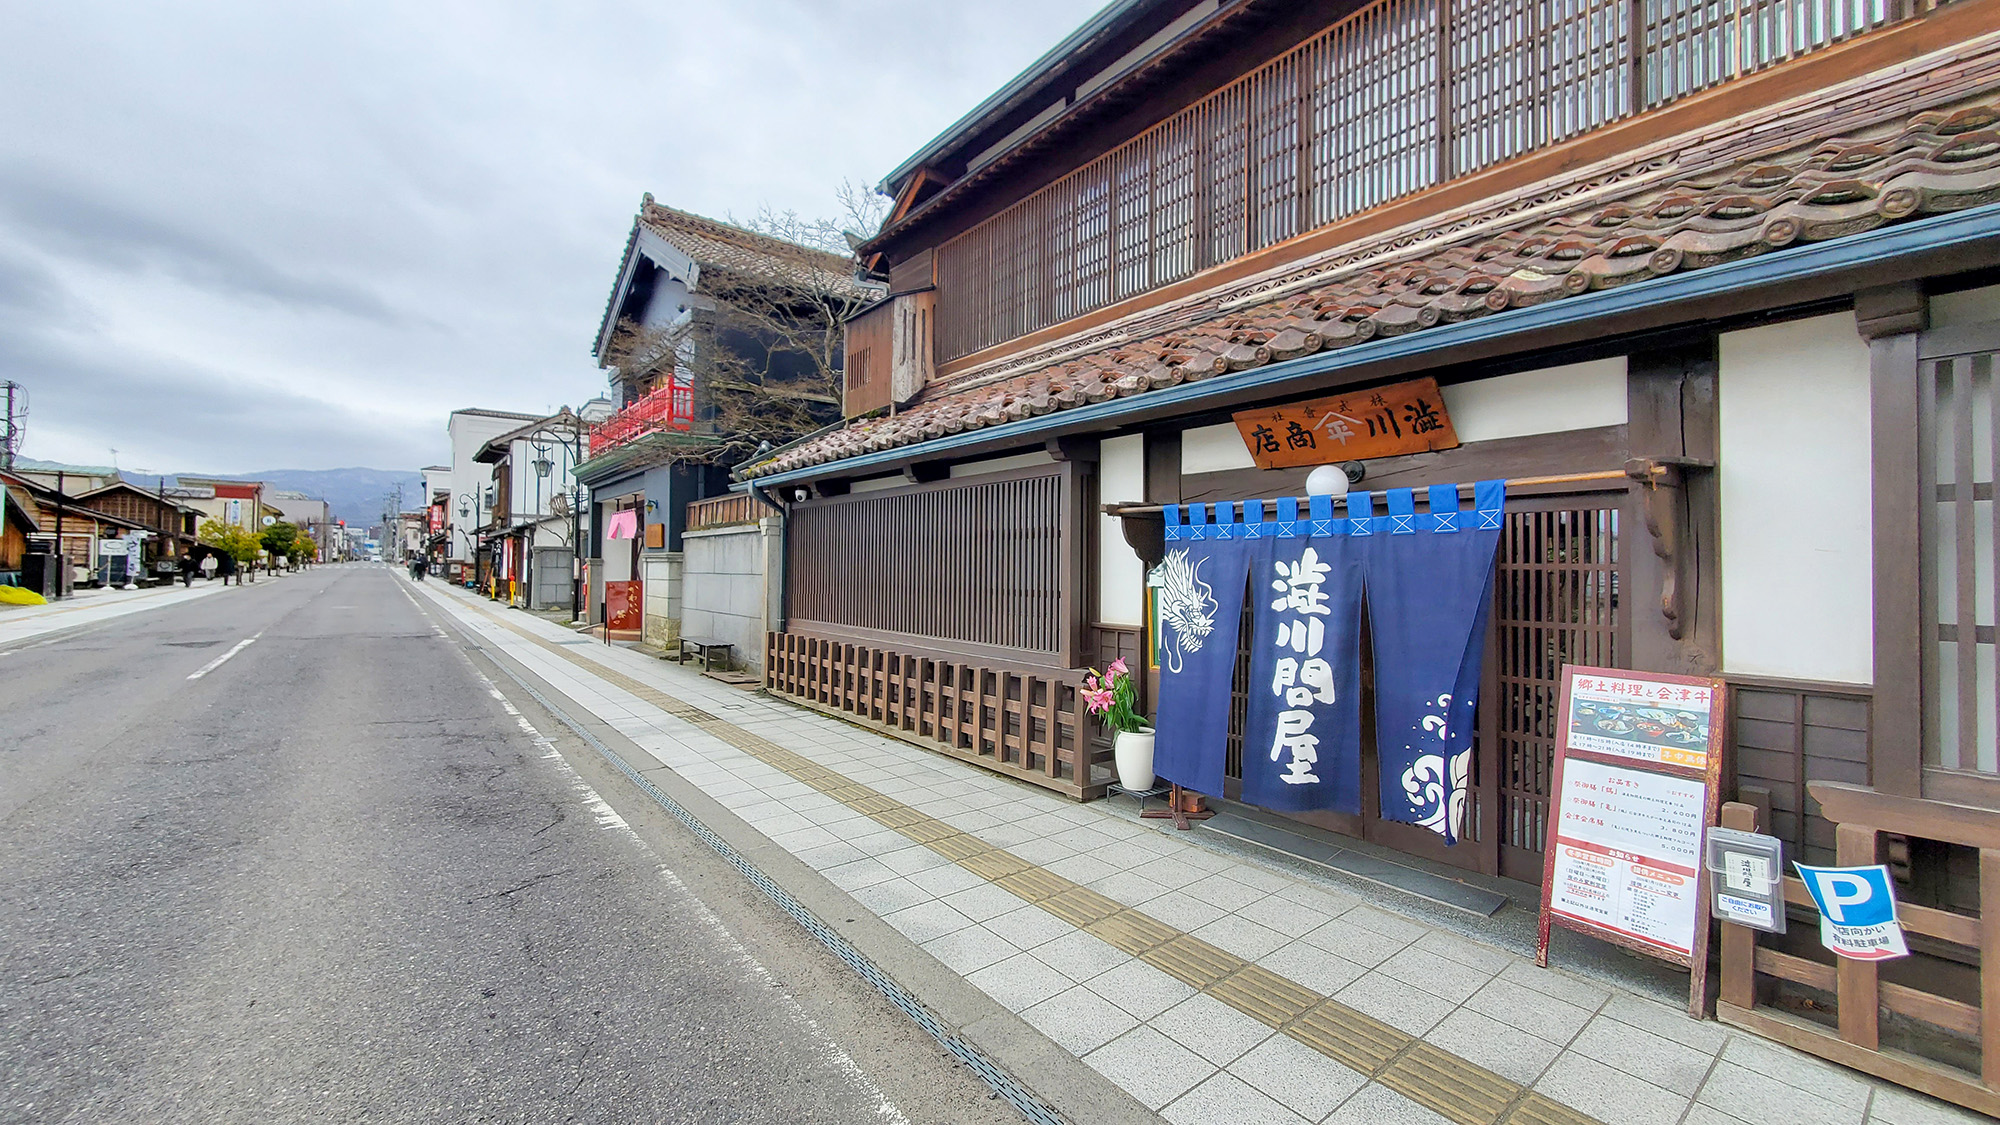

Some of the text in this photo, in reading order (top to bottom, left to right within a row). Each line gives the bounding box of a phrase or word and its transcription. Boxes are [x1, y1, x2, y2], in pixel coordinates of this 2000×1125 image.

[1577, 678, 1710, 704] 郷土料理と会津牛
[1662, 750, 1706, 765] 年中無休
[1608, 777, 1640, 789] お品書き
[1608, 849, 1640, 863] お知らせ
[1633, 866, 1682, 883] 提供メニュー
[1814, 872, 1872, 922] P
[1732, 905, 1757, 915] ください
